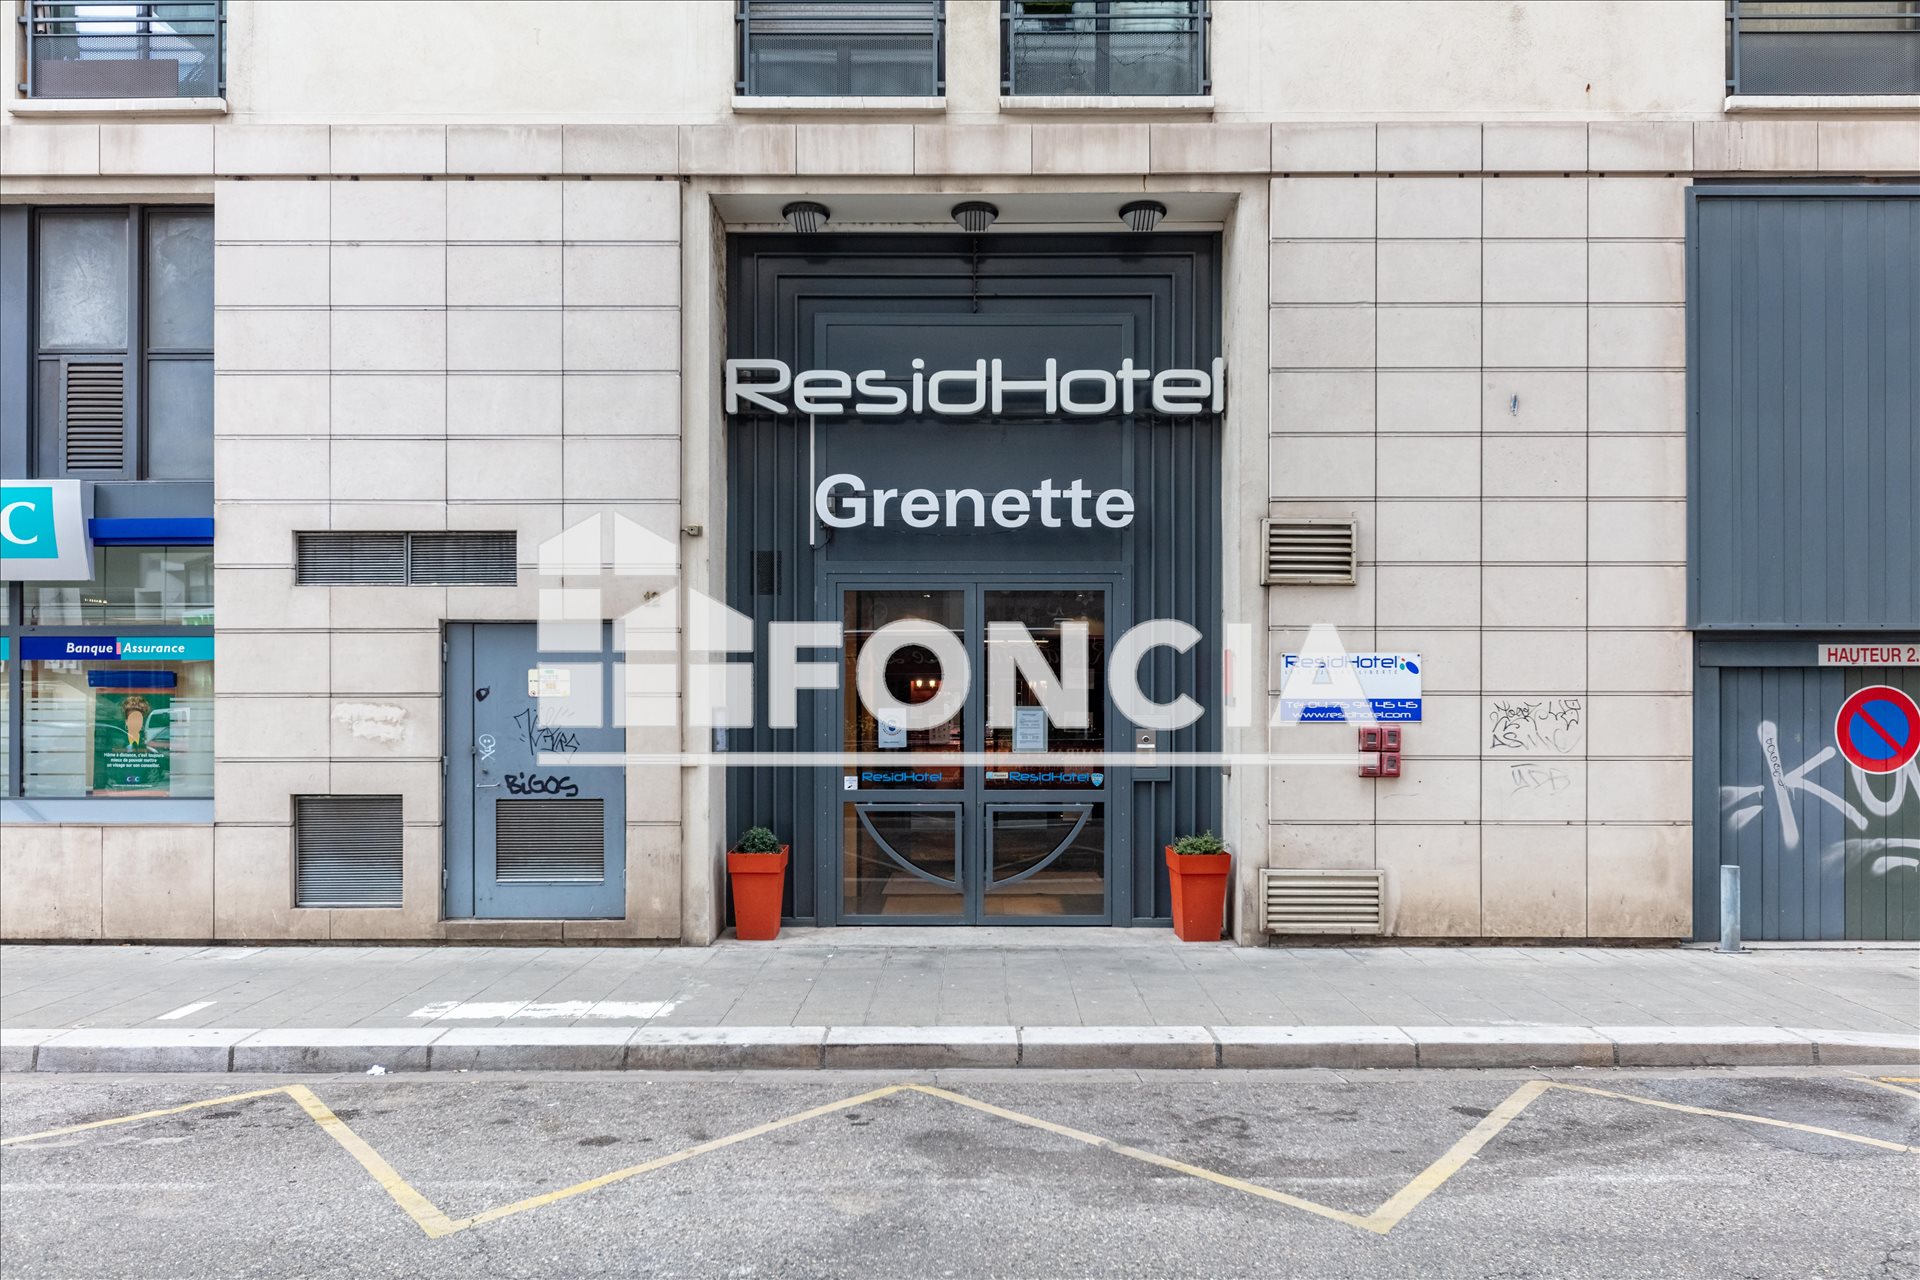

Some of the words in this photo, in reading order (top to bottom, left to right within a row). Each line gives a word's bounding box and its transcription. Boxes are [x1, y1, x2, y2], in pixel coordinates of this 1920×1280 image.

[725, 357, 1224, 415] ResidHotel
[815, 473, 1135, 528] Grenette
[66, 642, 114, 656] Banque
[123, 642, 186, 654] Assurance
[1827, 647, 1902, 663] HAUTEUR
[1285, 655, 1398, 668] ResidHotel
[861, 771, 943, 782] ResidHotel
[1009, 771, 1090, 782] ResidHotel
